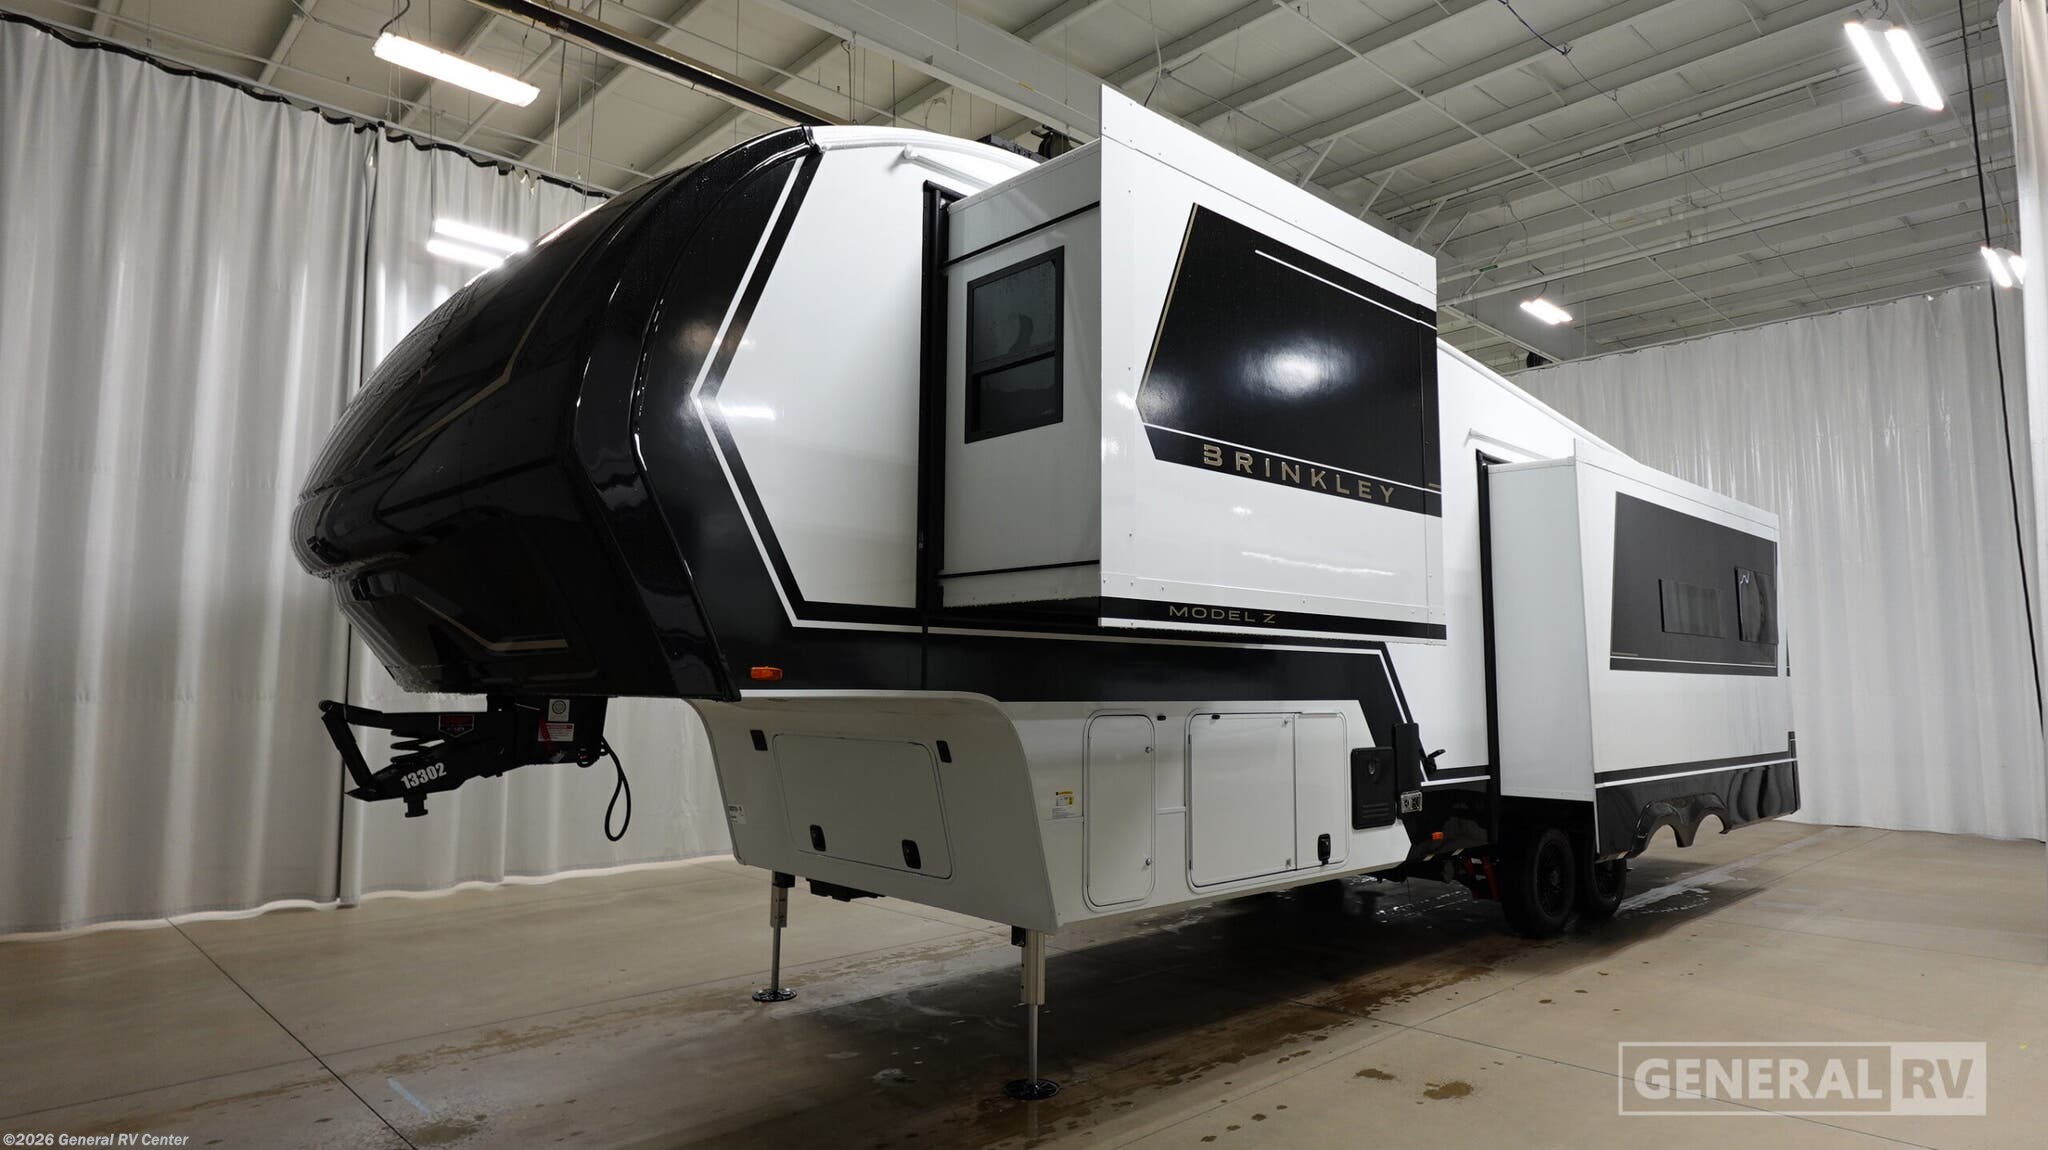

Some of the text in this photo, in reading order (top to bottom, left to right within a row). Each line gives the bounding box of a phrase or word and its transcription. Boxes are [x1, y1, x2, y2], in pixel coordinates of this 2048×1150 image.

[1203, 443, 1394, 504] BRINKLEY
[1169, 605, 1276, 624] MODEL Z
[400, 762, 447, 789] 13302
